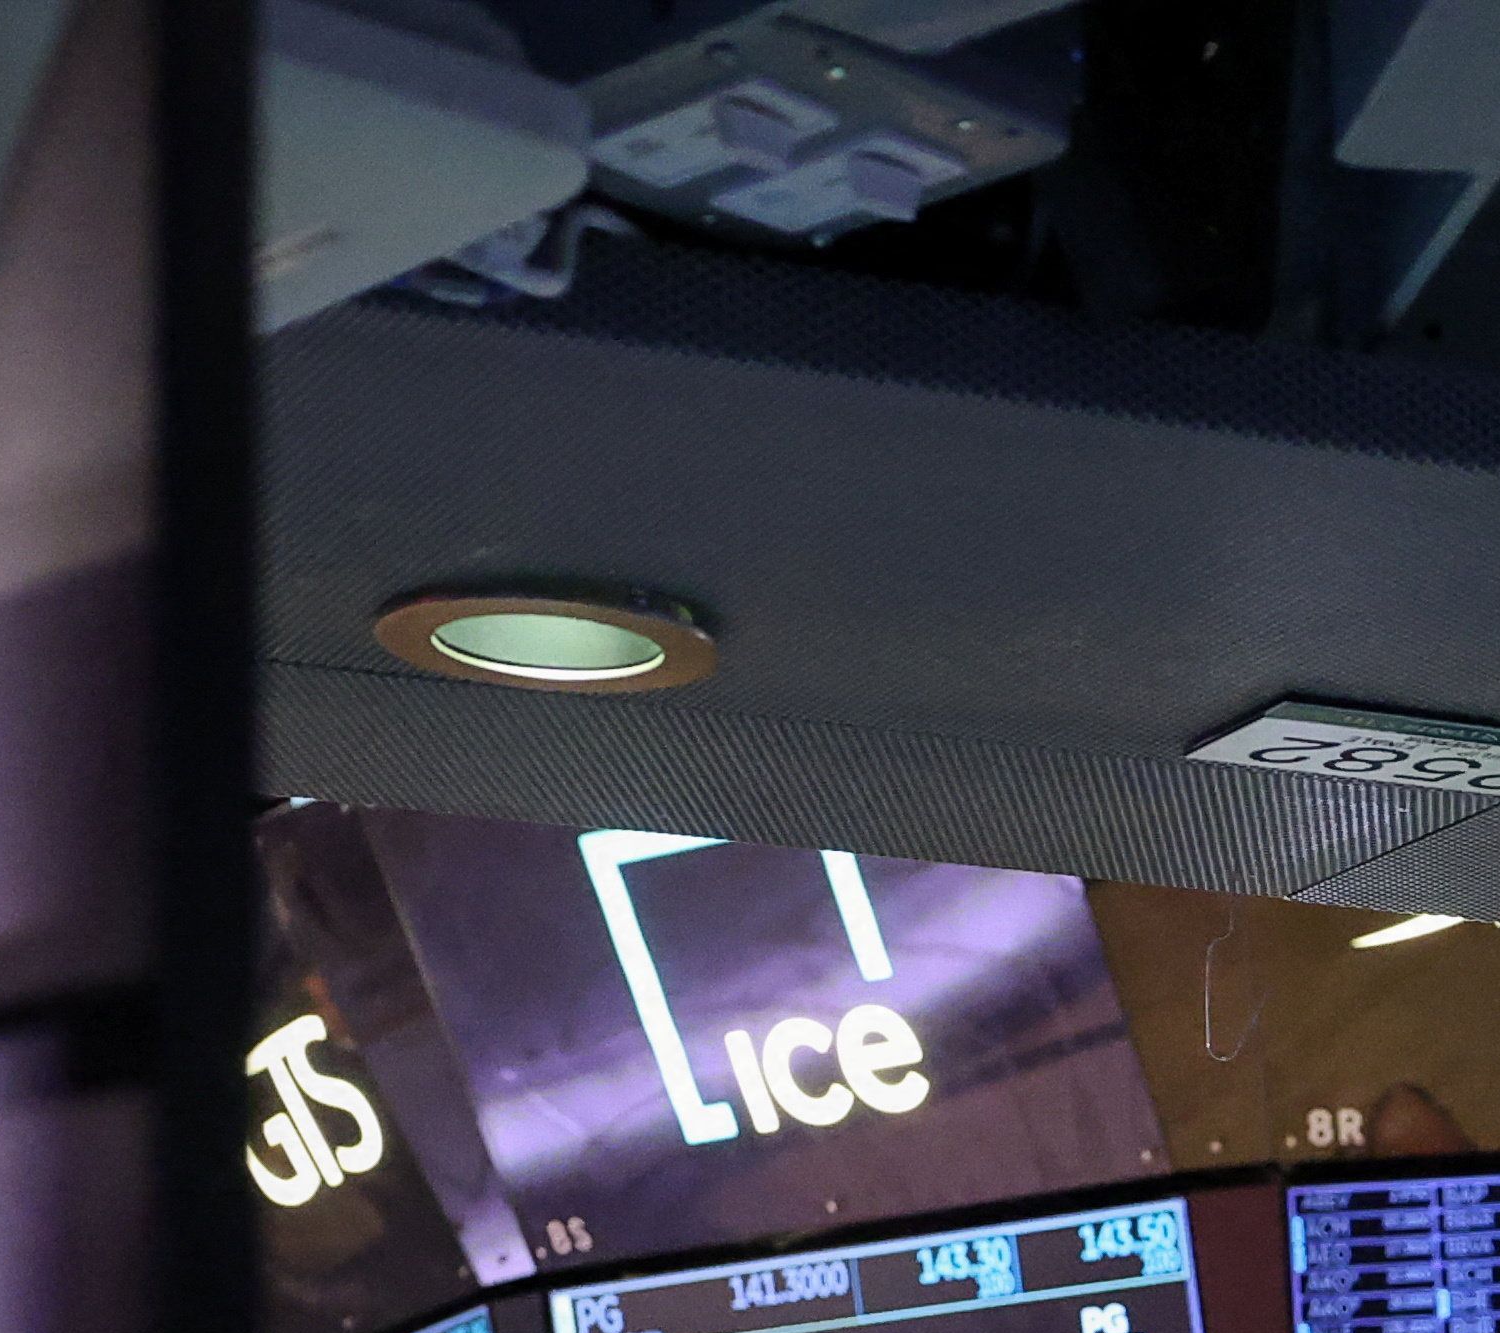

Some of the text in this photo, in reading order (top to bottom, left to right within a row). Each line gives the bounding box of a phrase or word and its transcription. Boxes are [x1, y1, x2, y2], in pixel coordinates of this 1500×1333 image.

[246, 1014, 382, 1206] GTS
[1306, 1108, 1365, 1147] 8R
[728, 1259, 850, 1311] 141.3000
